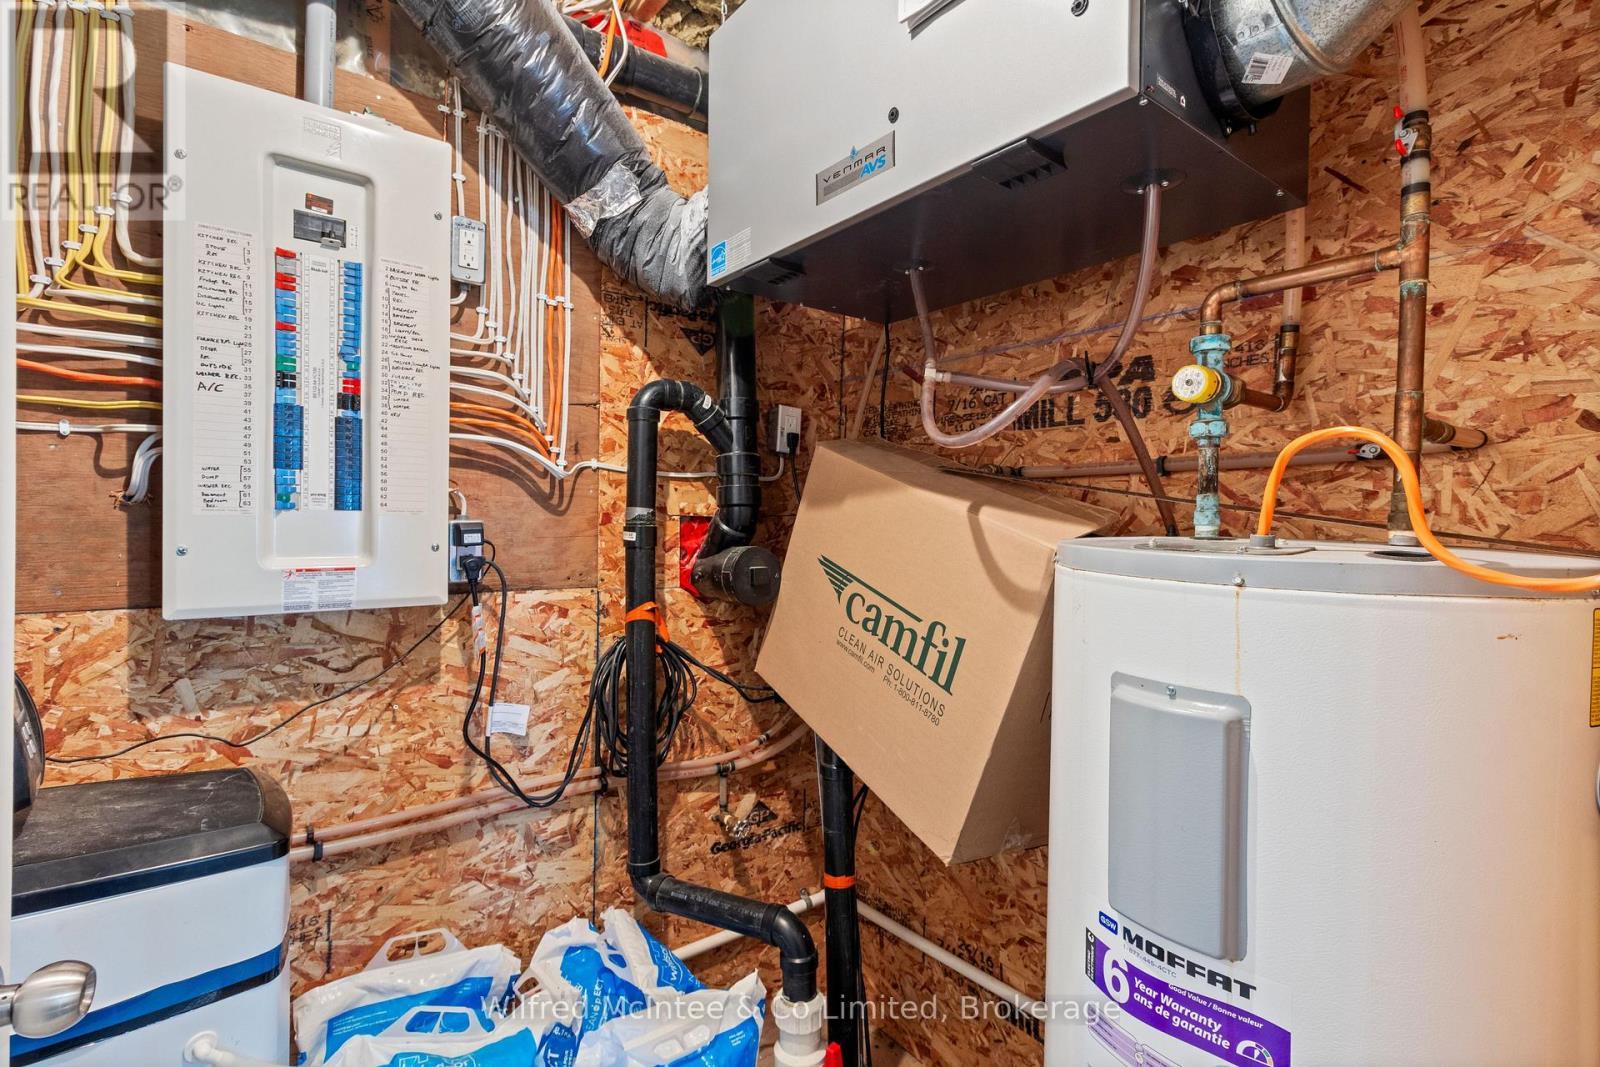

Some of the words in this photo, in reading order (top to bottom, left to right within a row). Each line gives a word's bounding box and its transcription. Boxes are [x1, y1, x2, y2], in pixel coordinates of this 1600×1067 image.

[823, 146, 886, 183] VENMAR
[860, 154, 886, 178] AVS
[197, 381, 224, 392] A/C
[838, 626, 867, 655] CLEAN
[867, 649, 885, 670] AIR
[886, 663, 946, 718] SOLUTIONS
[845, 592, 967, 696] Camfil
[1103, 948, 1130, 1004] 6
[1122, 925, 1257, 1000] MOFFAT
[1133, 976, 1159, 999] Year
[1160, 992, 1222, 1033] Warranty
[1133, 992, 1153, 1010] ans
[1154, 1004, 1170, 1020] de
[1171, 1015, 1231, 1050] garantie
[1168, 983, 1187, 997] Good
[1187, 993, 1207, 1007] Value
[1212, 1003, 1237, 1019] Bonne
[1238, 1014, 1264, 1029] valeur
